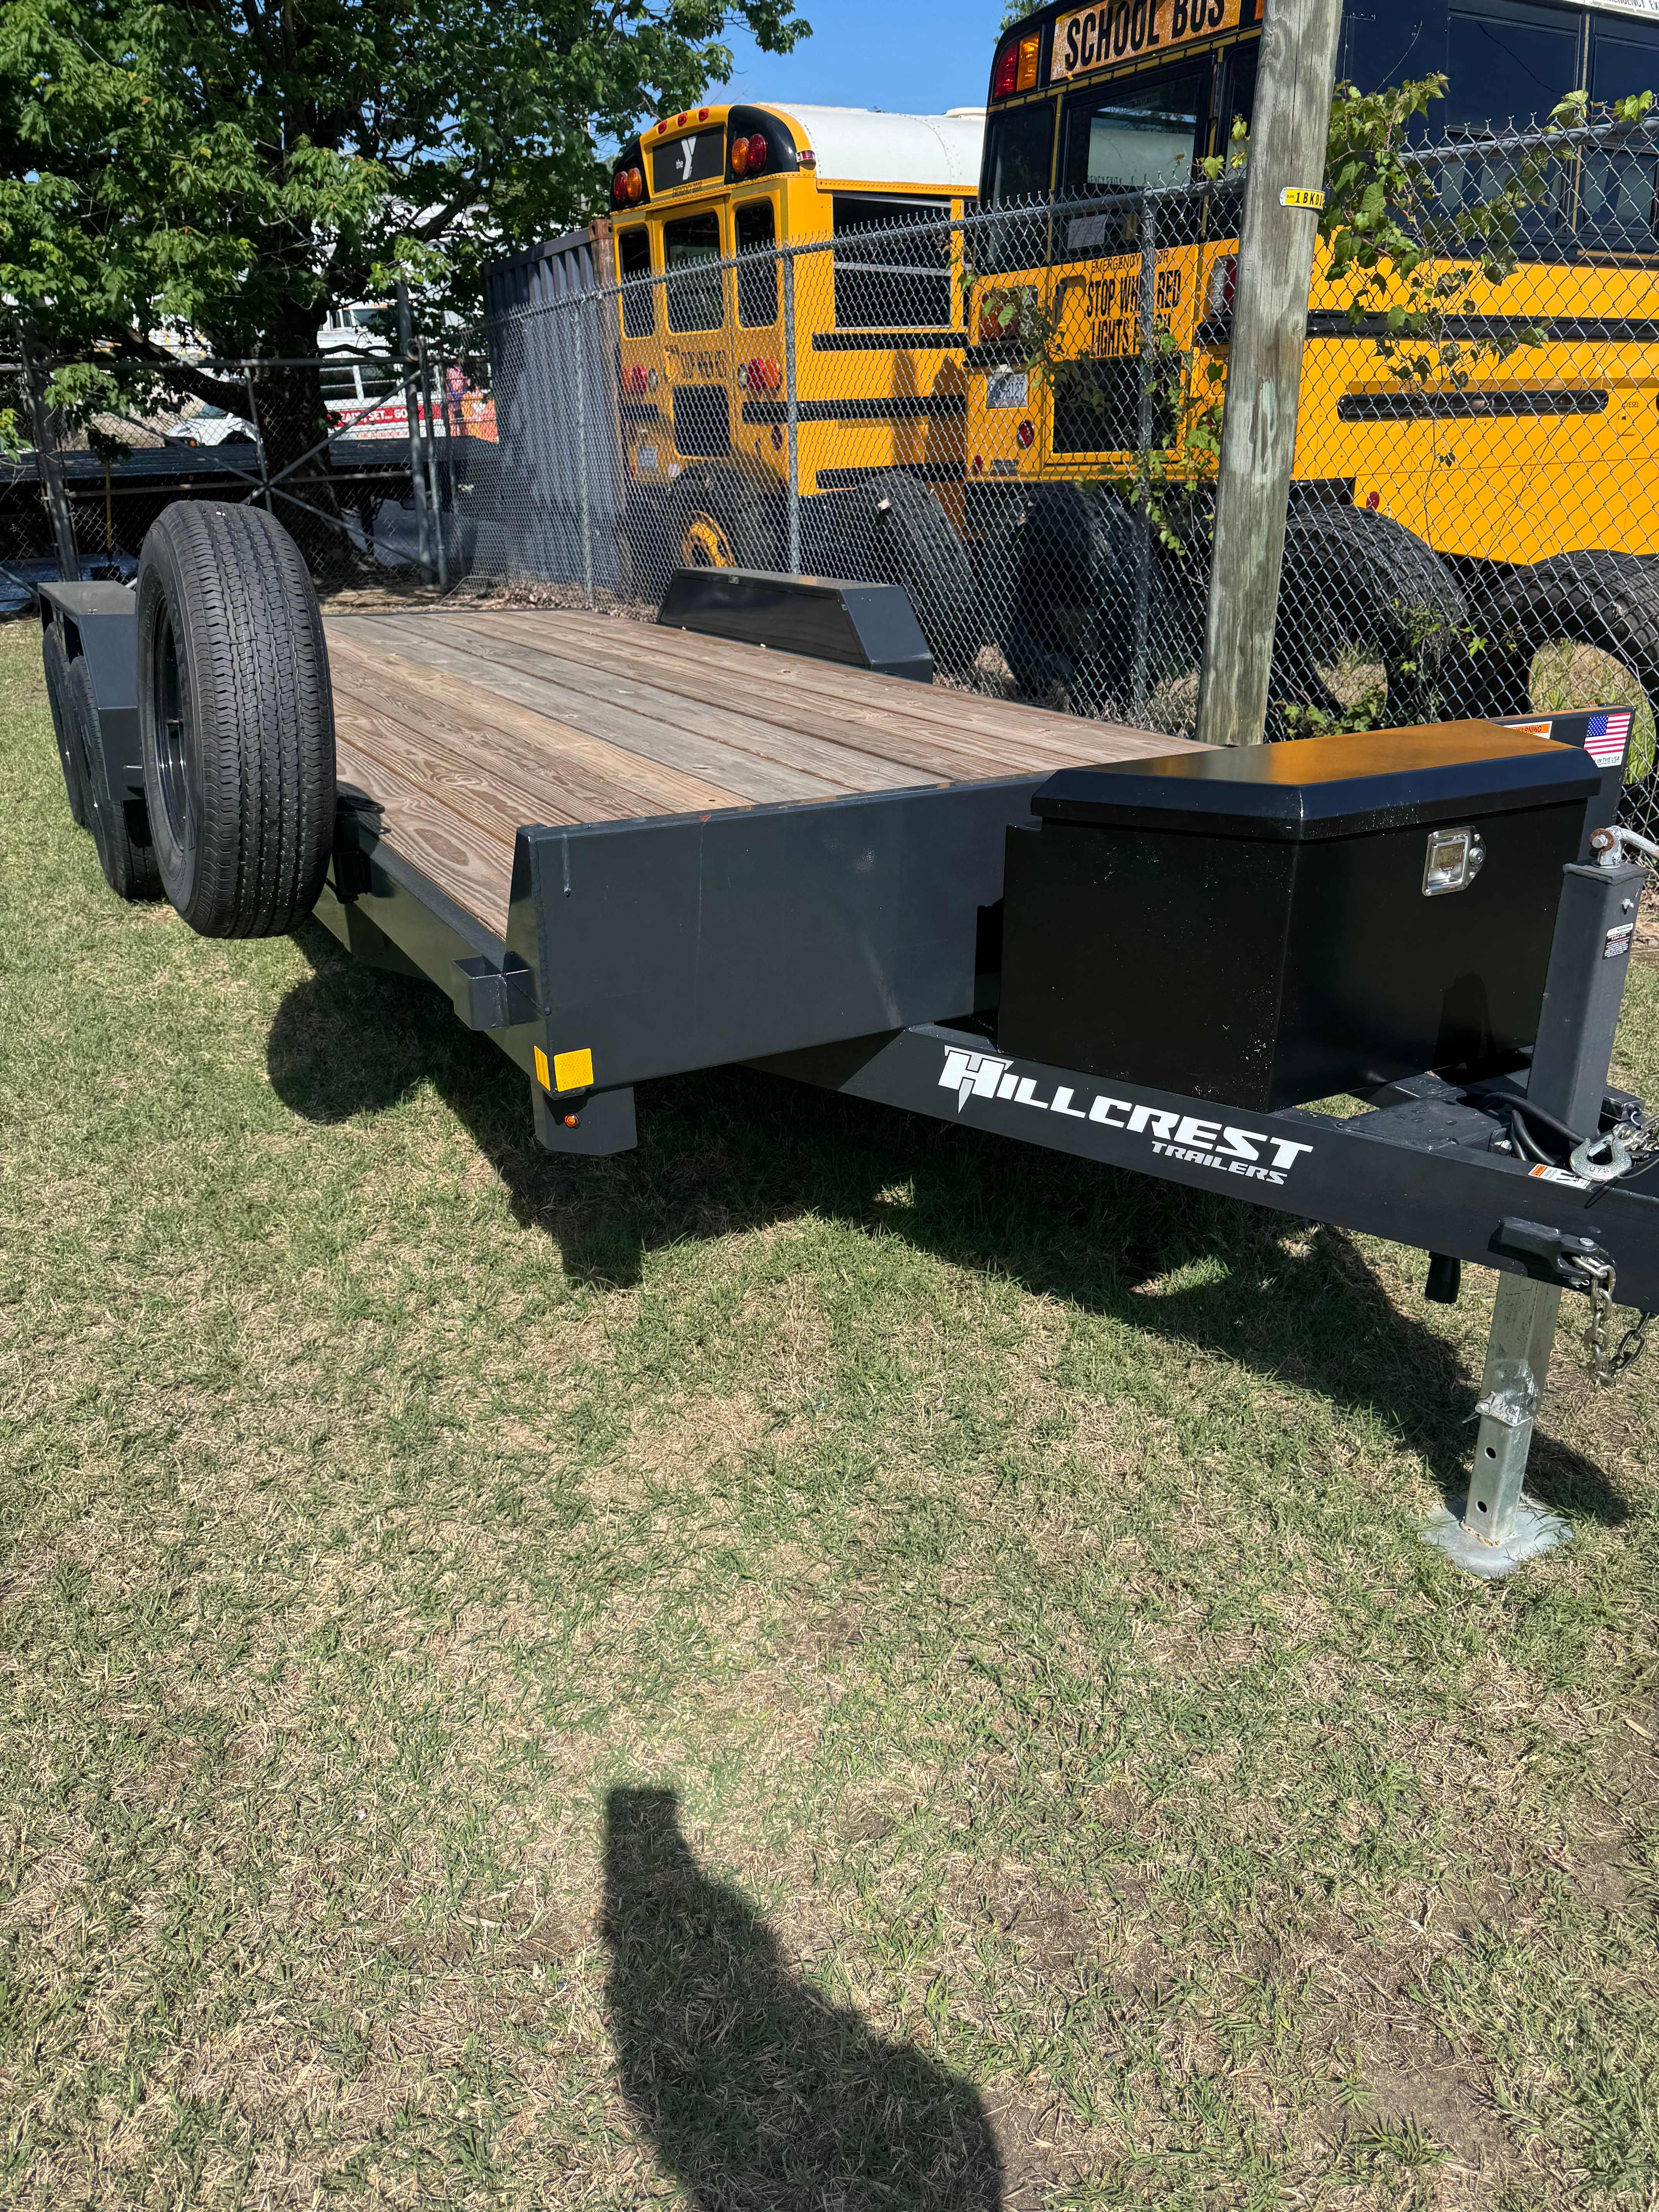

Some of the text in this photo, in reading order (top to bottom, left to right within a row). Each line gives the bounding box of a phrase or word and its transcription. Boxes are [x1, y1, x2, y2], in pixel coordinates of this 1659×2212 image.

[1065, 0, 1224, 71] SCHOOL BUS
[1091, 253, 1141, 273] EMERGENCY
[1087, 278, 1115, 318] STOP
[1156, 270, 1181, 309] RED
[1090, 317, 1130, 357] LIGHTS
[938, 1045, 1314, 1170] HILLCREST
[1152, 1141, 1288, 1185] TRAILERS
